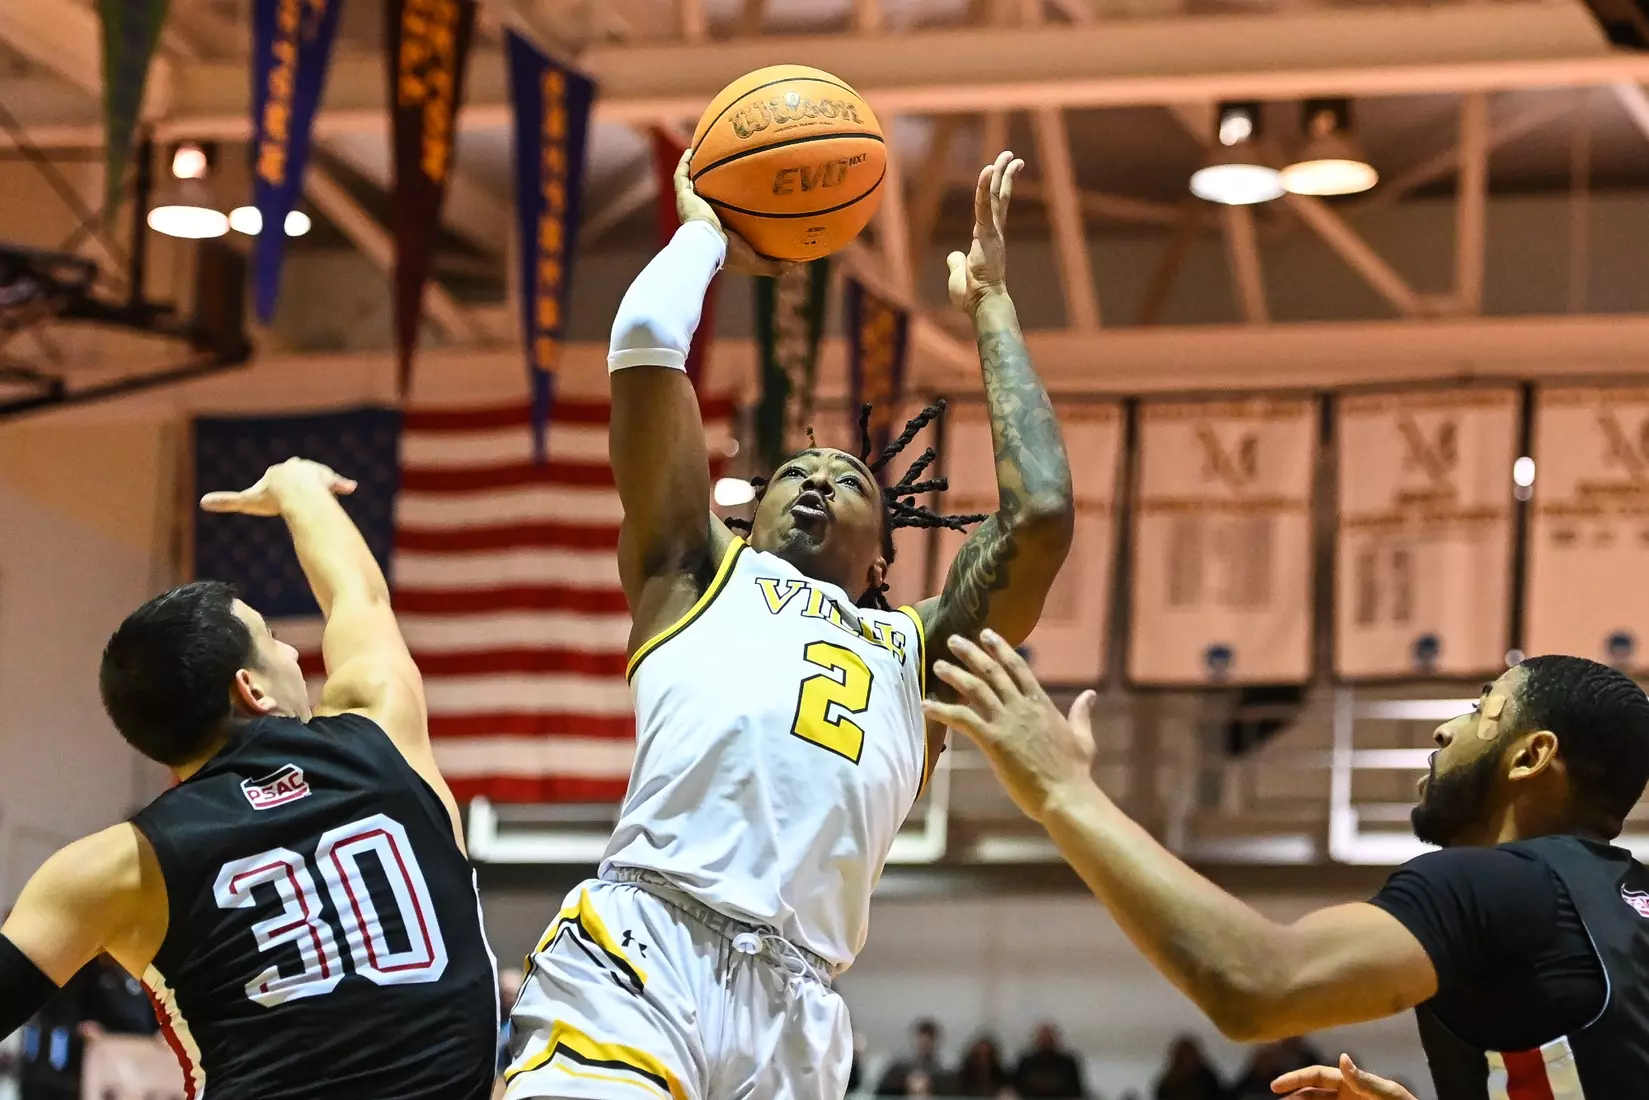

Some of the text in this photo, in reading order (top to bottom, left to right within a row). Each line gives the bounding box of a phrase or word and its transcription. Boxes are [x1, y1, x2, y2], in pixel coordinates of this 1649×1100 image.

[728, 98, 864, 139] Wilson
[772, 153, 867, 196] EVO NXT
[790, 640, 874, 766] 2
[246, 771, 306, 801] PSAC
[212, 812, 449, 1009] 30
